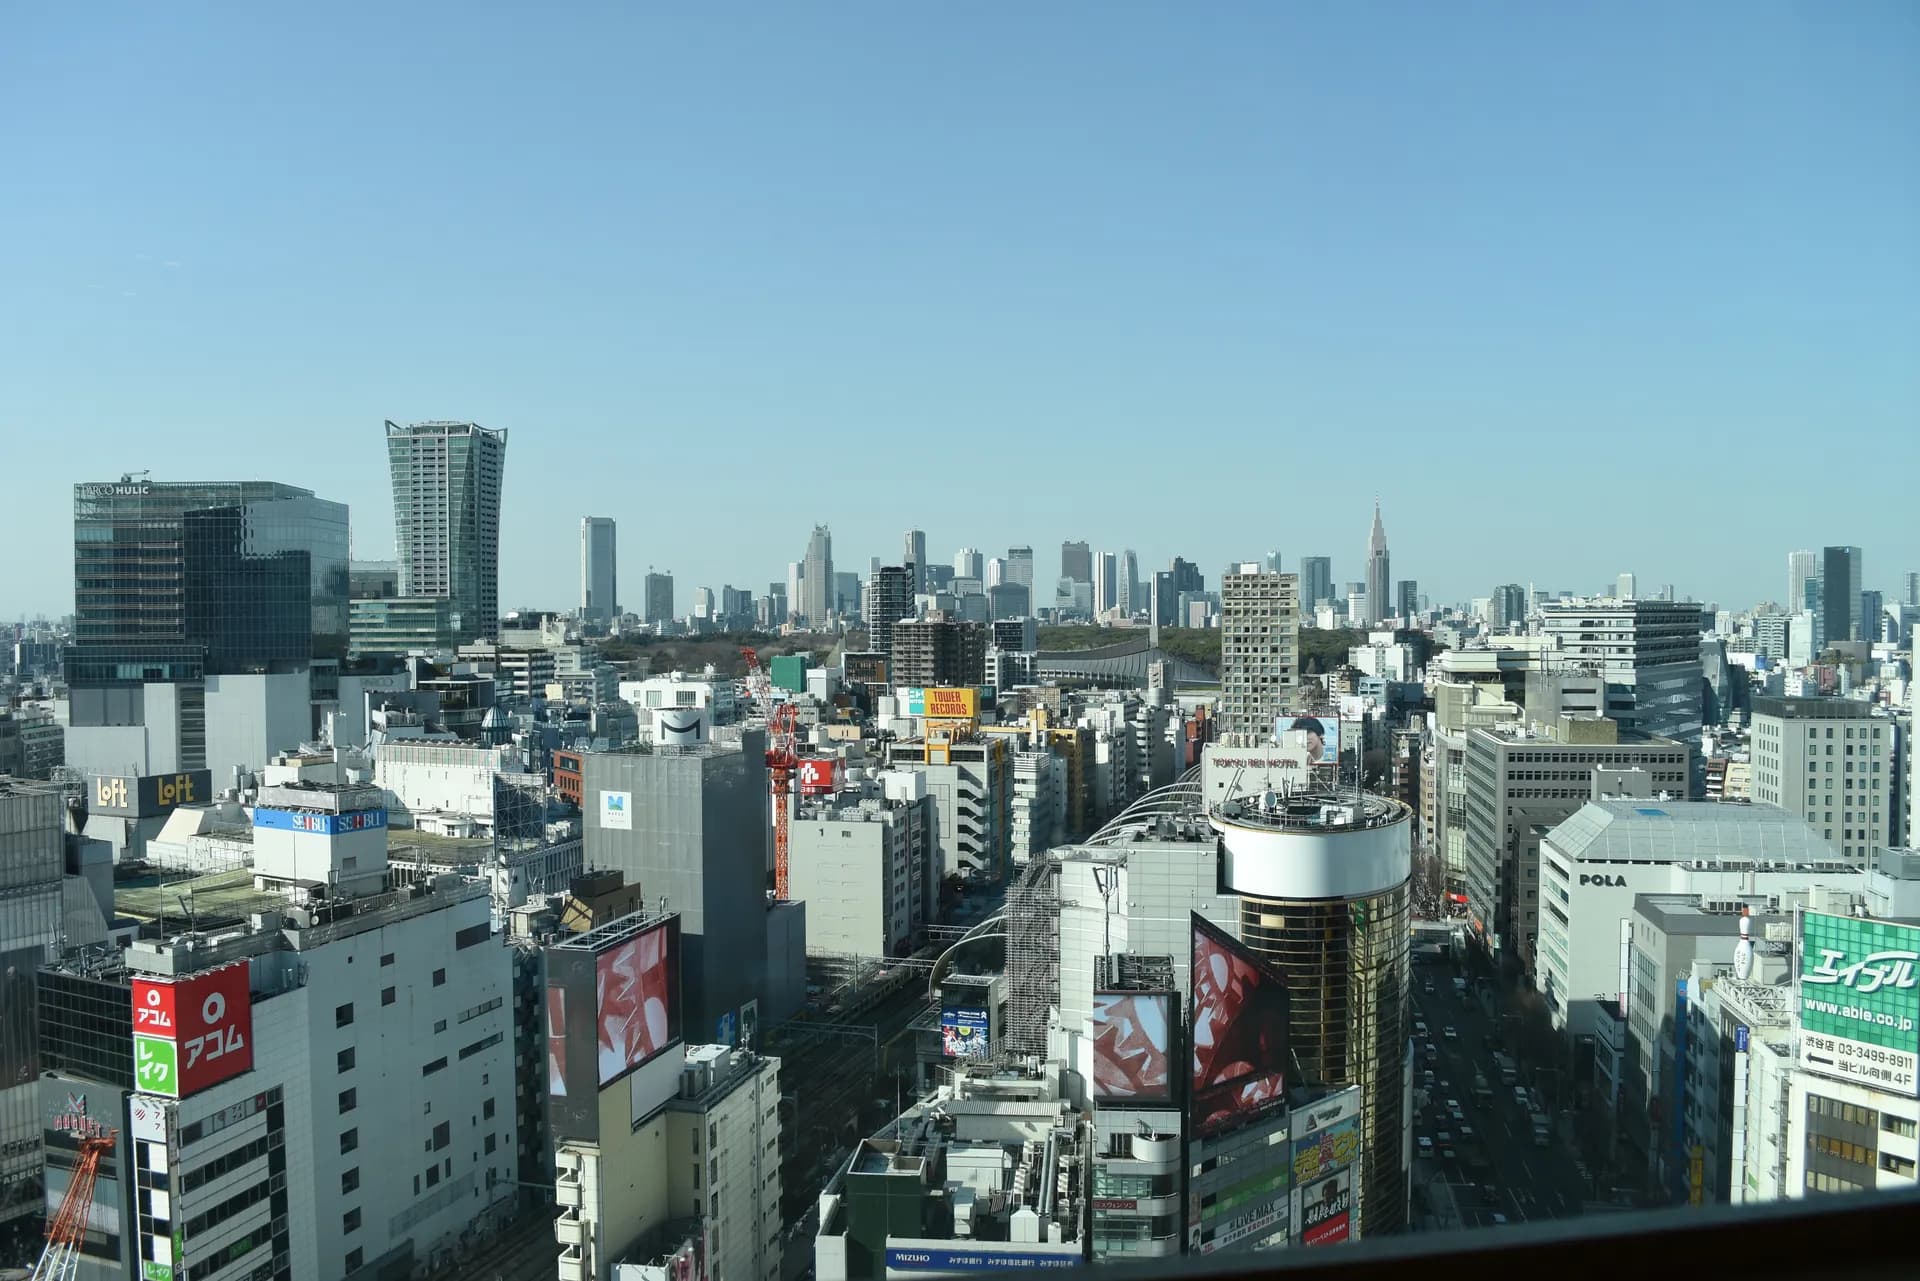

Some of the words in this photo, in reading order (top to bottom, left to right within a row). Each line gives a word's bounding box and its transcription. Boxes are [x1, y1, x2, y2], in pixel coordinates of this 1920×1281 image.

[116, 486, 149, 494] HULIC
[909, 690, 924, 698] ニト
[933, 691, 962, 703] TOWER
[930, 703, 967, 715] RECORDS
[292, 815, 326, 832] SEIBU
[339, 811, 380, 831] SEIBU
[1579, 874, 1628, 887] POLA
[1800, 949, 1919, 993] エイブル
[138, 1007, 171, 1027] アコム
[1805, 998, 1913, 1032] www.able.co.jp
[184, 1023, 244, 1069] アコム
[1805, 1035, 1835, 1052] 渋谷店
[1838, 1042, 1912, 1070] 03-3499-8911
[1838, 1058, 1892, 1082] 当ビル向側
[1893, 1073, 1912, 1085] 4F
[895, 1253, 930, 1262] MIZUHO
[948, 1256, 983, 1265] みずほ銀行
[987, 1258, 1036, 1267] みずほ信託銀行
